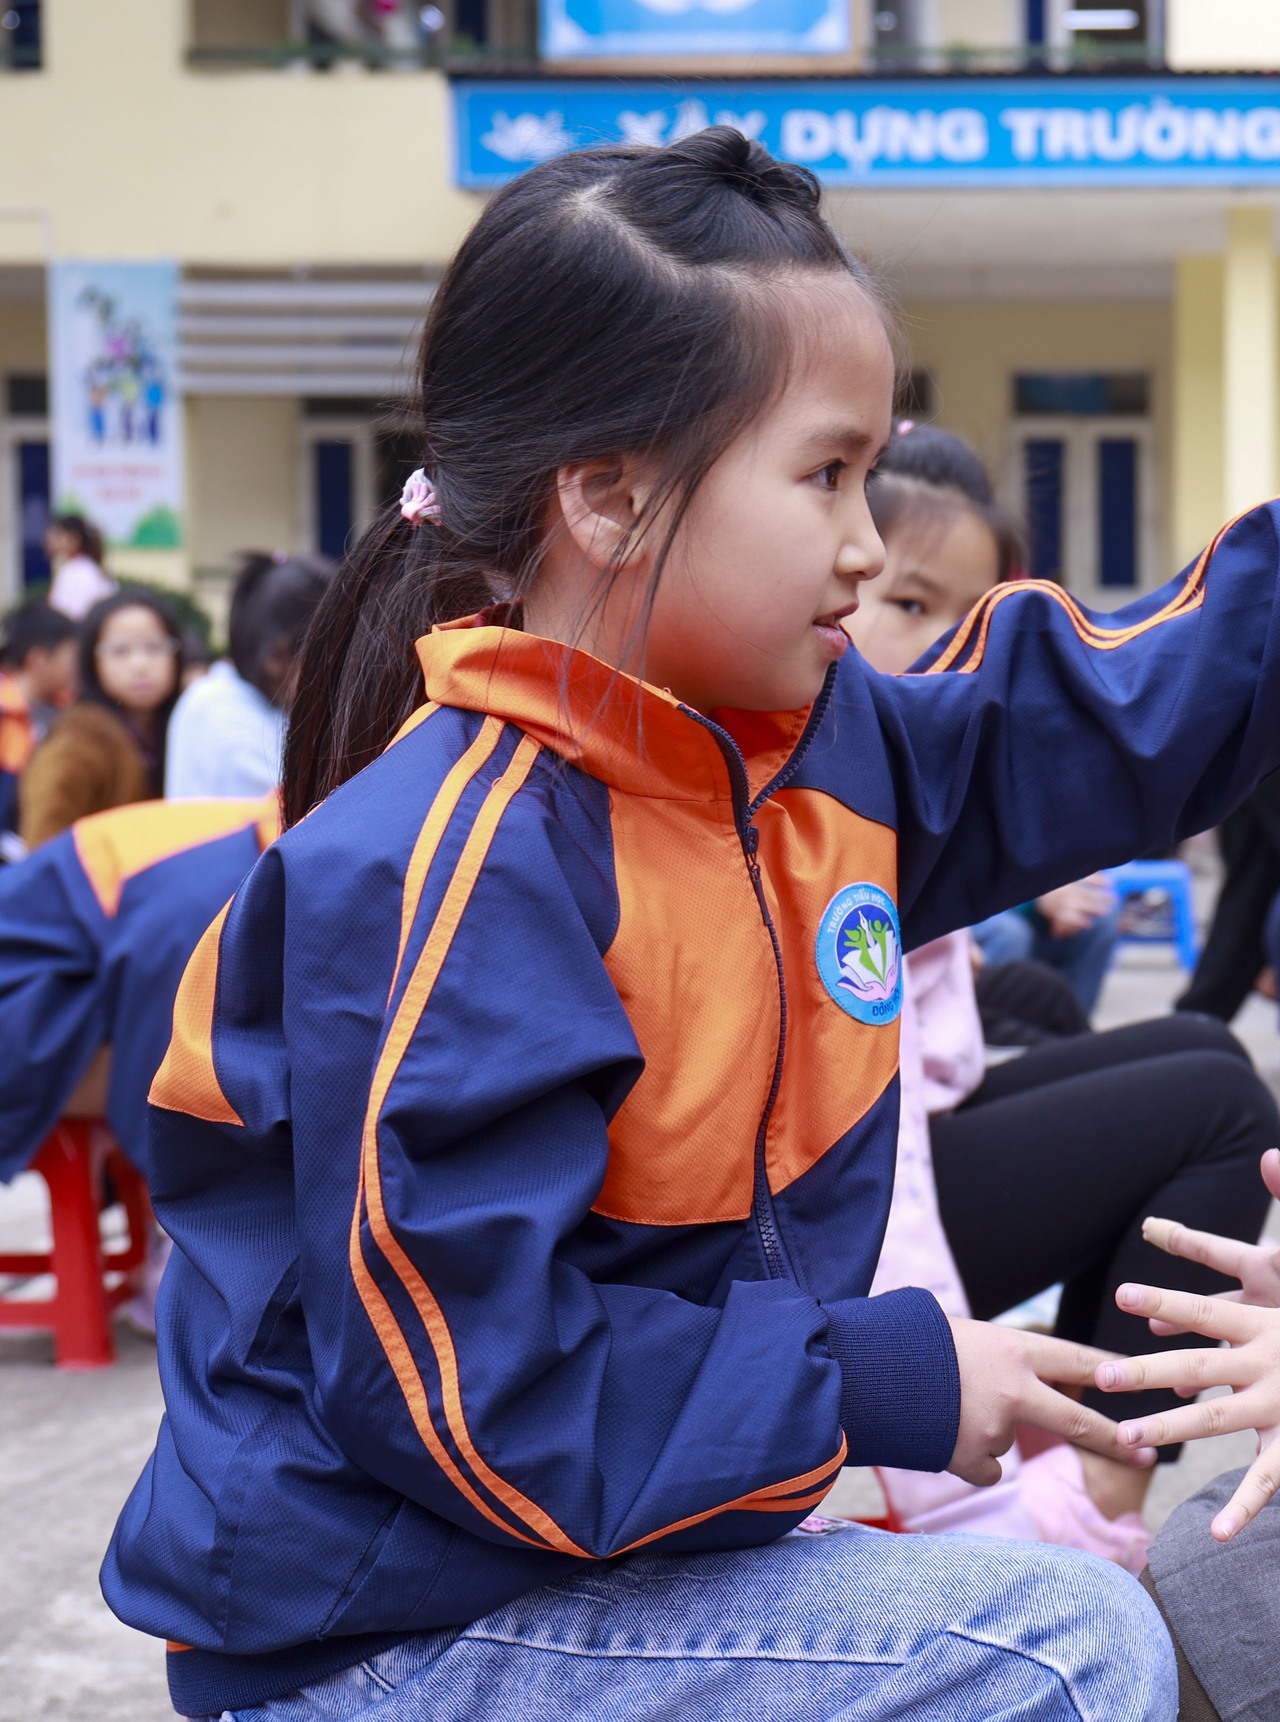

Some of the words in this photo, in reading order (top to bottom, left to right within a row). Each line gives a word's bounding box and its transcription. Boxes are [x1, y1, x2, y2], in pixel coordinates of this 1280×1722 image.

[782, 104, 988, 173] DỰNG
[827, 897, 853, 933] TRƯỜNG
[853, 888, 870, 902] TIỂU
[871, 893, 885, 906] HỌC
